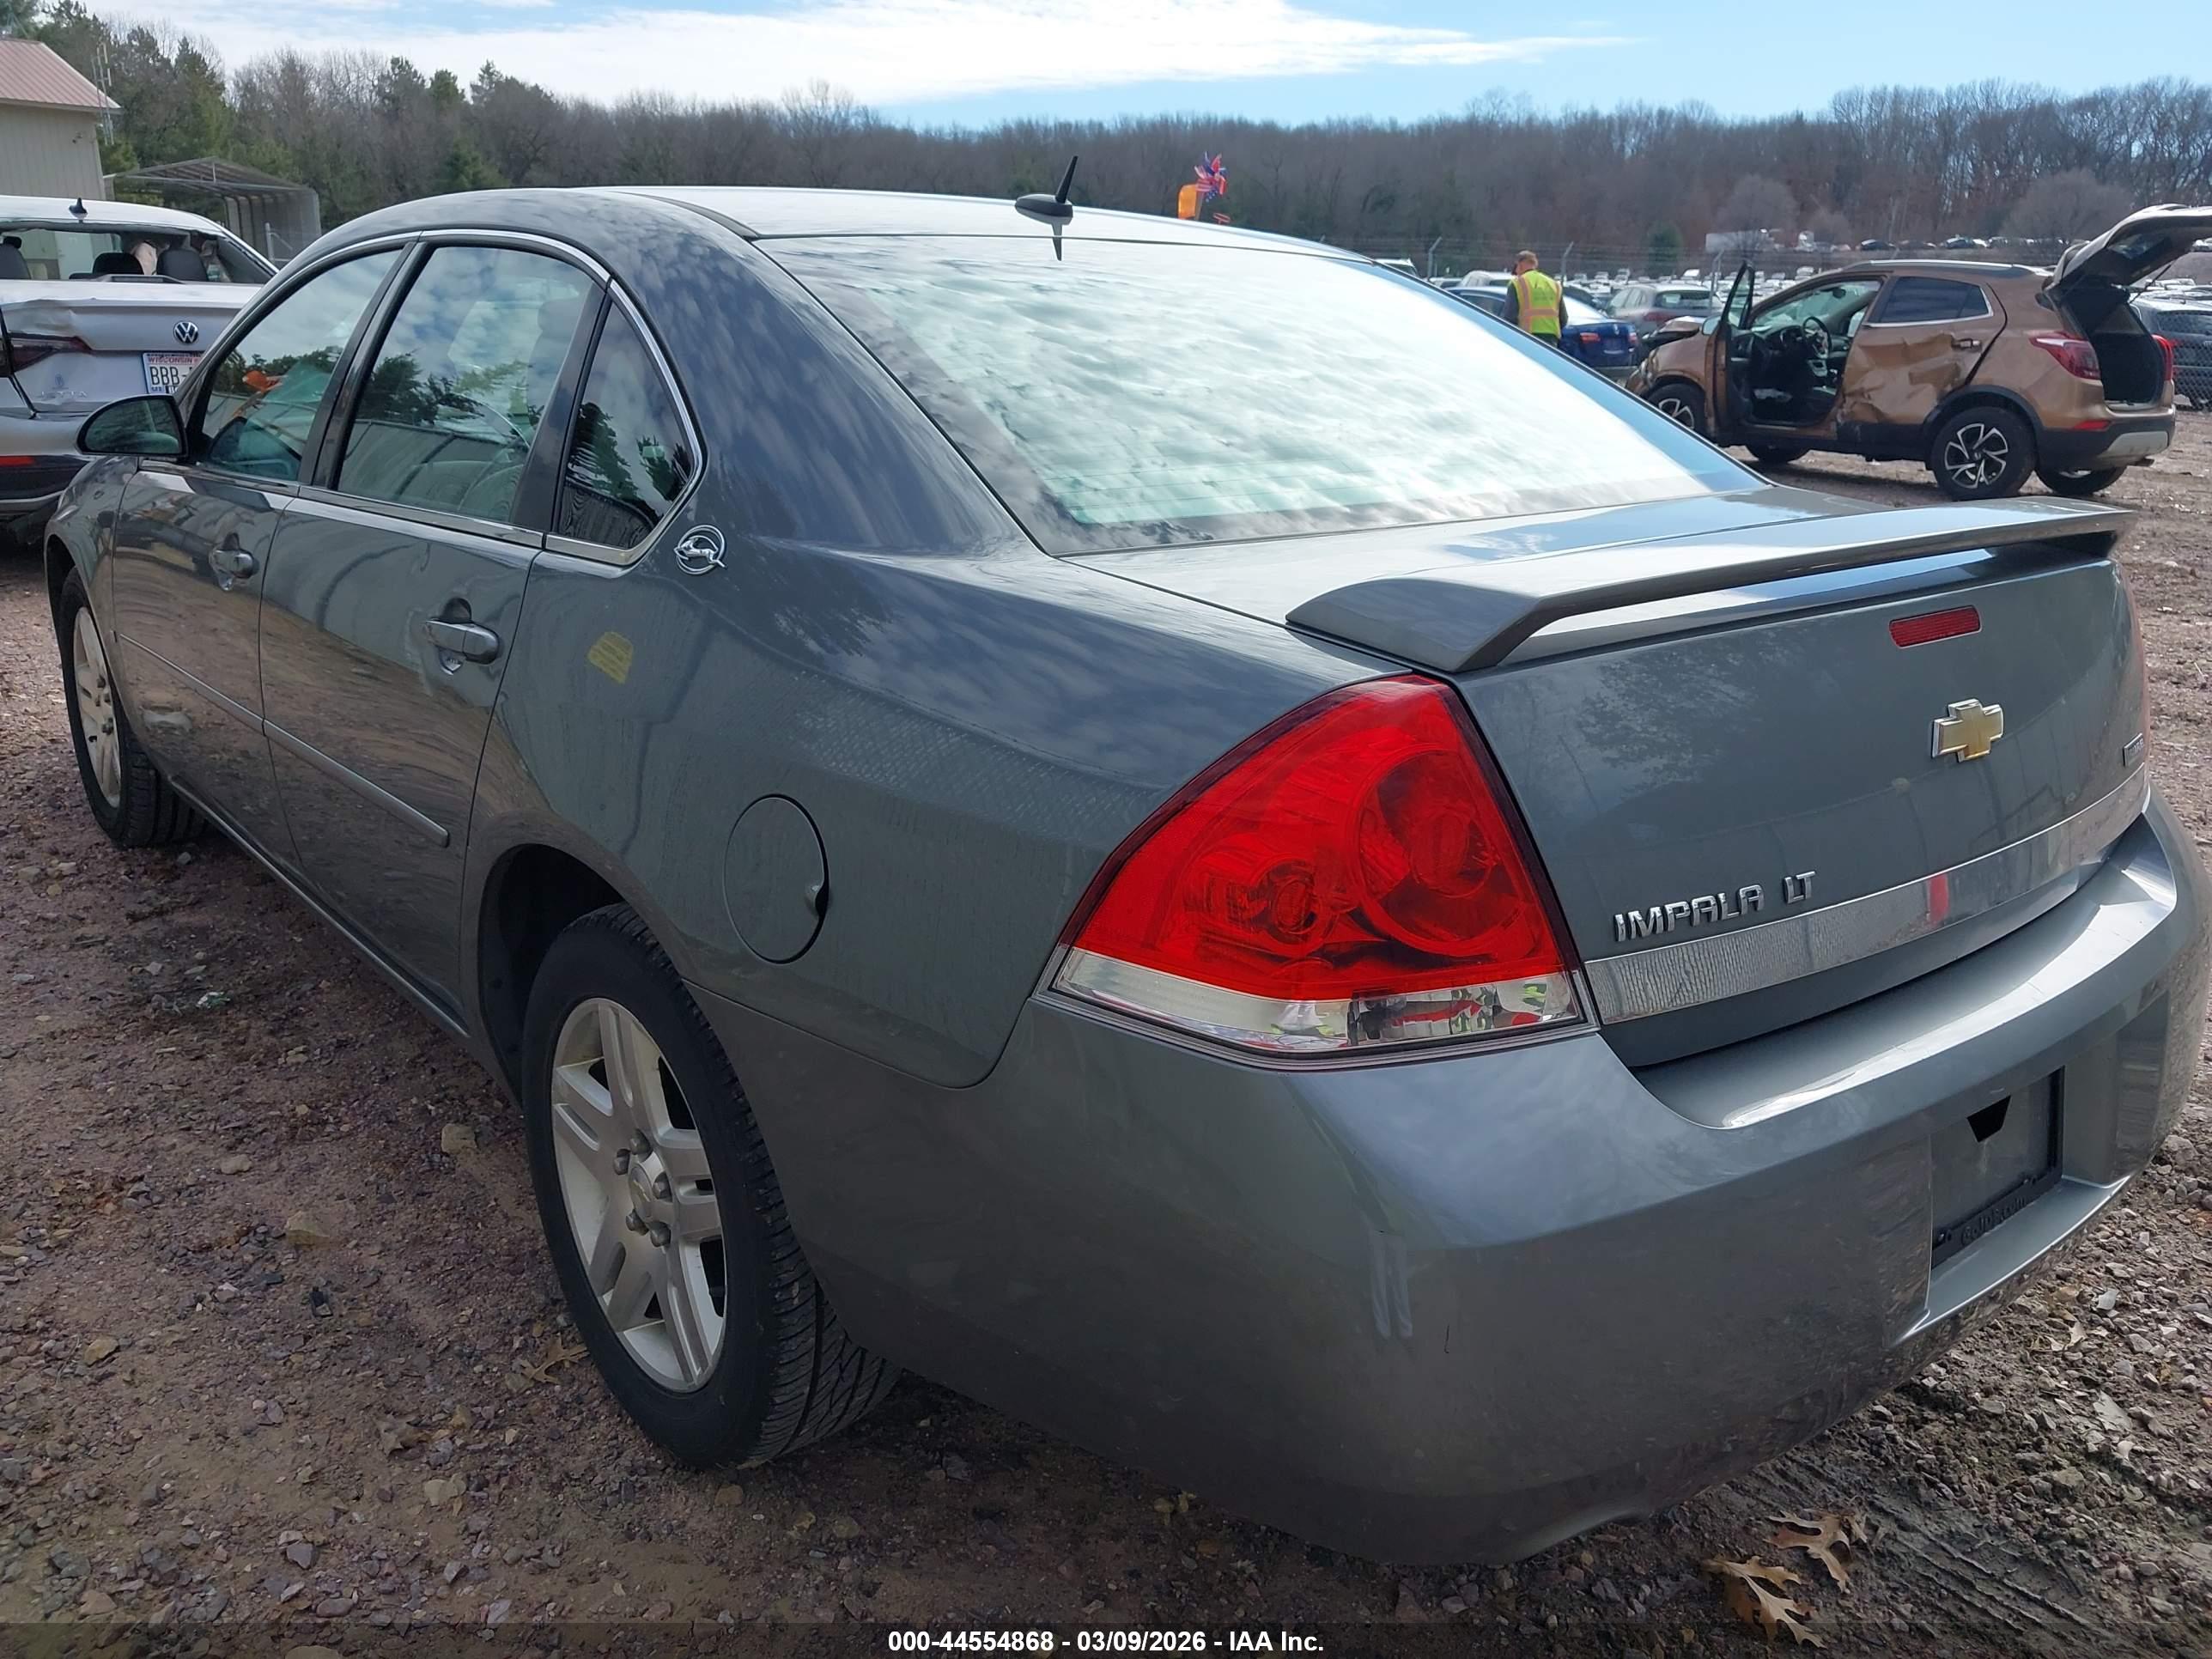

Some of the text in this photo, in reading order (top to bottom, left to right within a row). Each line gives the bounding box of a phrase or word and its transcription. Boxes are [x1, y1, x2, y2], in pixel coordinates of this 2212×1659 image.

[173, 322, 198, 344] VW
[1614, 871, 1816, 942] IMPALA LT
